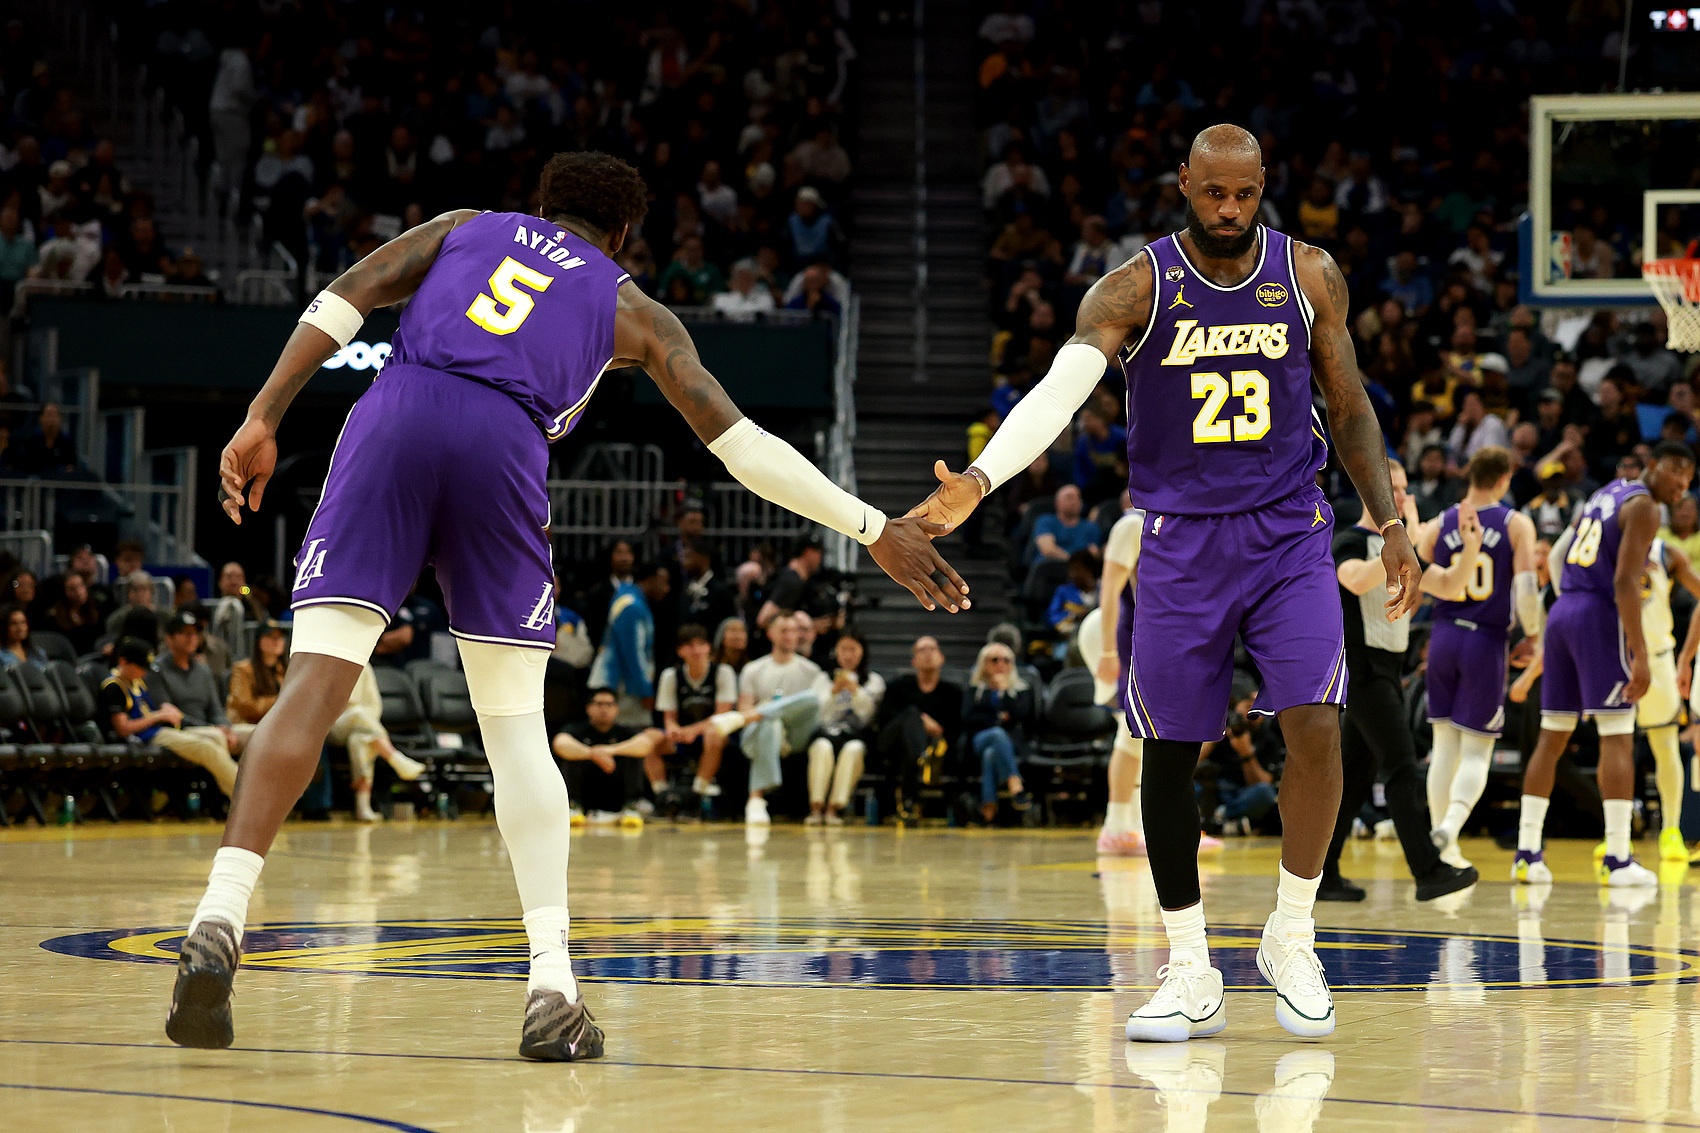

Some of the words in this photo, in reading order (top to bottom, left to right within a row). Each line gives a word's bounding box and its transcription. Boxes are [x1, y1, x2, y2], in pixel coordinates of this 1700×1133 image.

[513, 225, 588, 271] AYTON
[464, 255, 555, 336] 5
[1259, 289, 1286, 300] bibigo
[1190, 369, 1272, 443] 23
[292, 538, 328, 593] LA
[520, 581, 555, 631] LA
